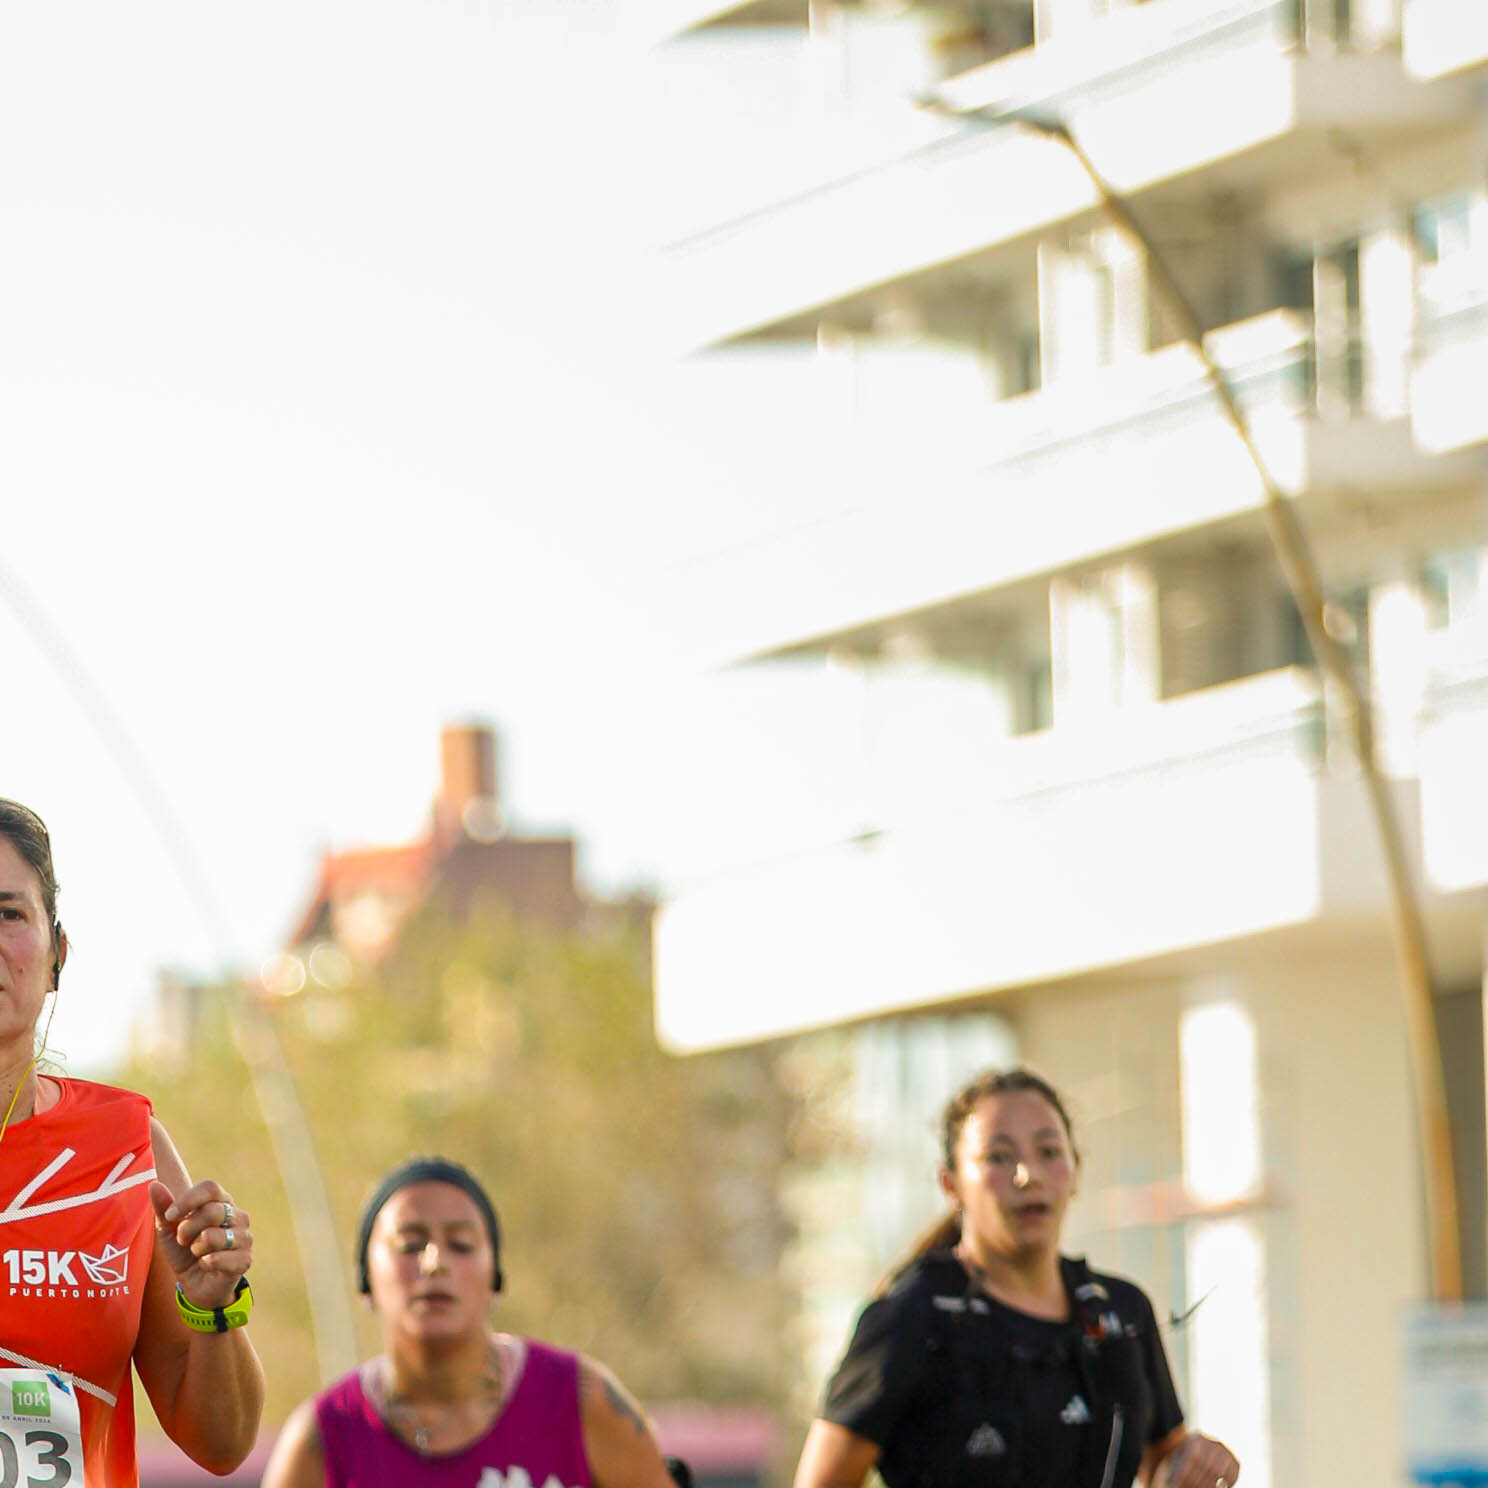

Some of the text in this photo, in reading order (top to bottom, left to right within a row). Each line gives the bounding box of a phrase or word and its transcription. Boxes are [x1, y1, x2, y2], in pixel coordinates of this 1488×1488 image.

[3, 1249, 79, 1285] 15K
[9, 1287, 80, 1298] PUERTO
[17, 1391, 47, 1408] 10K
